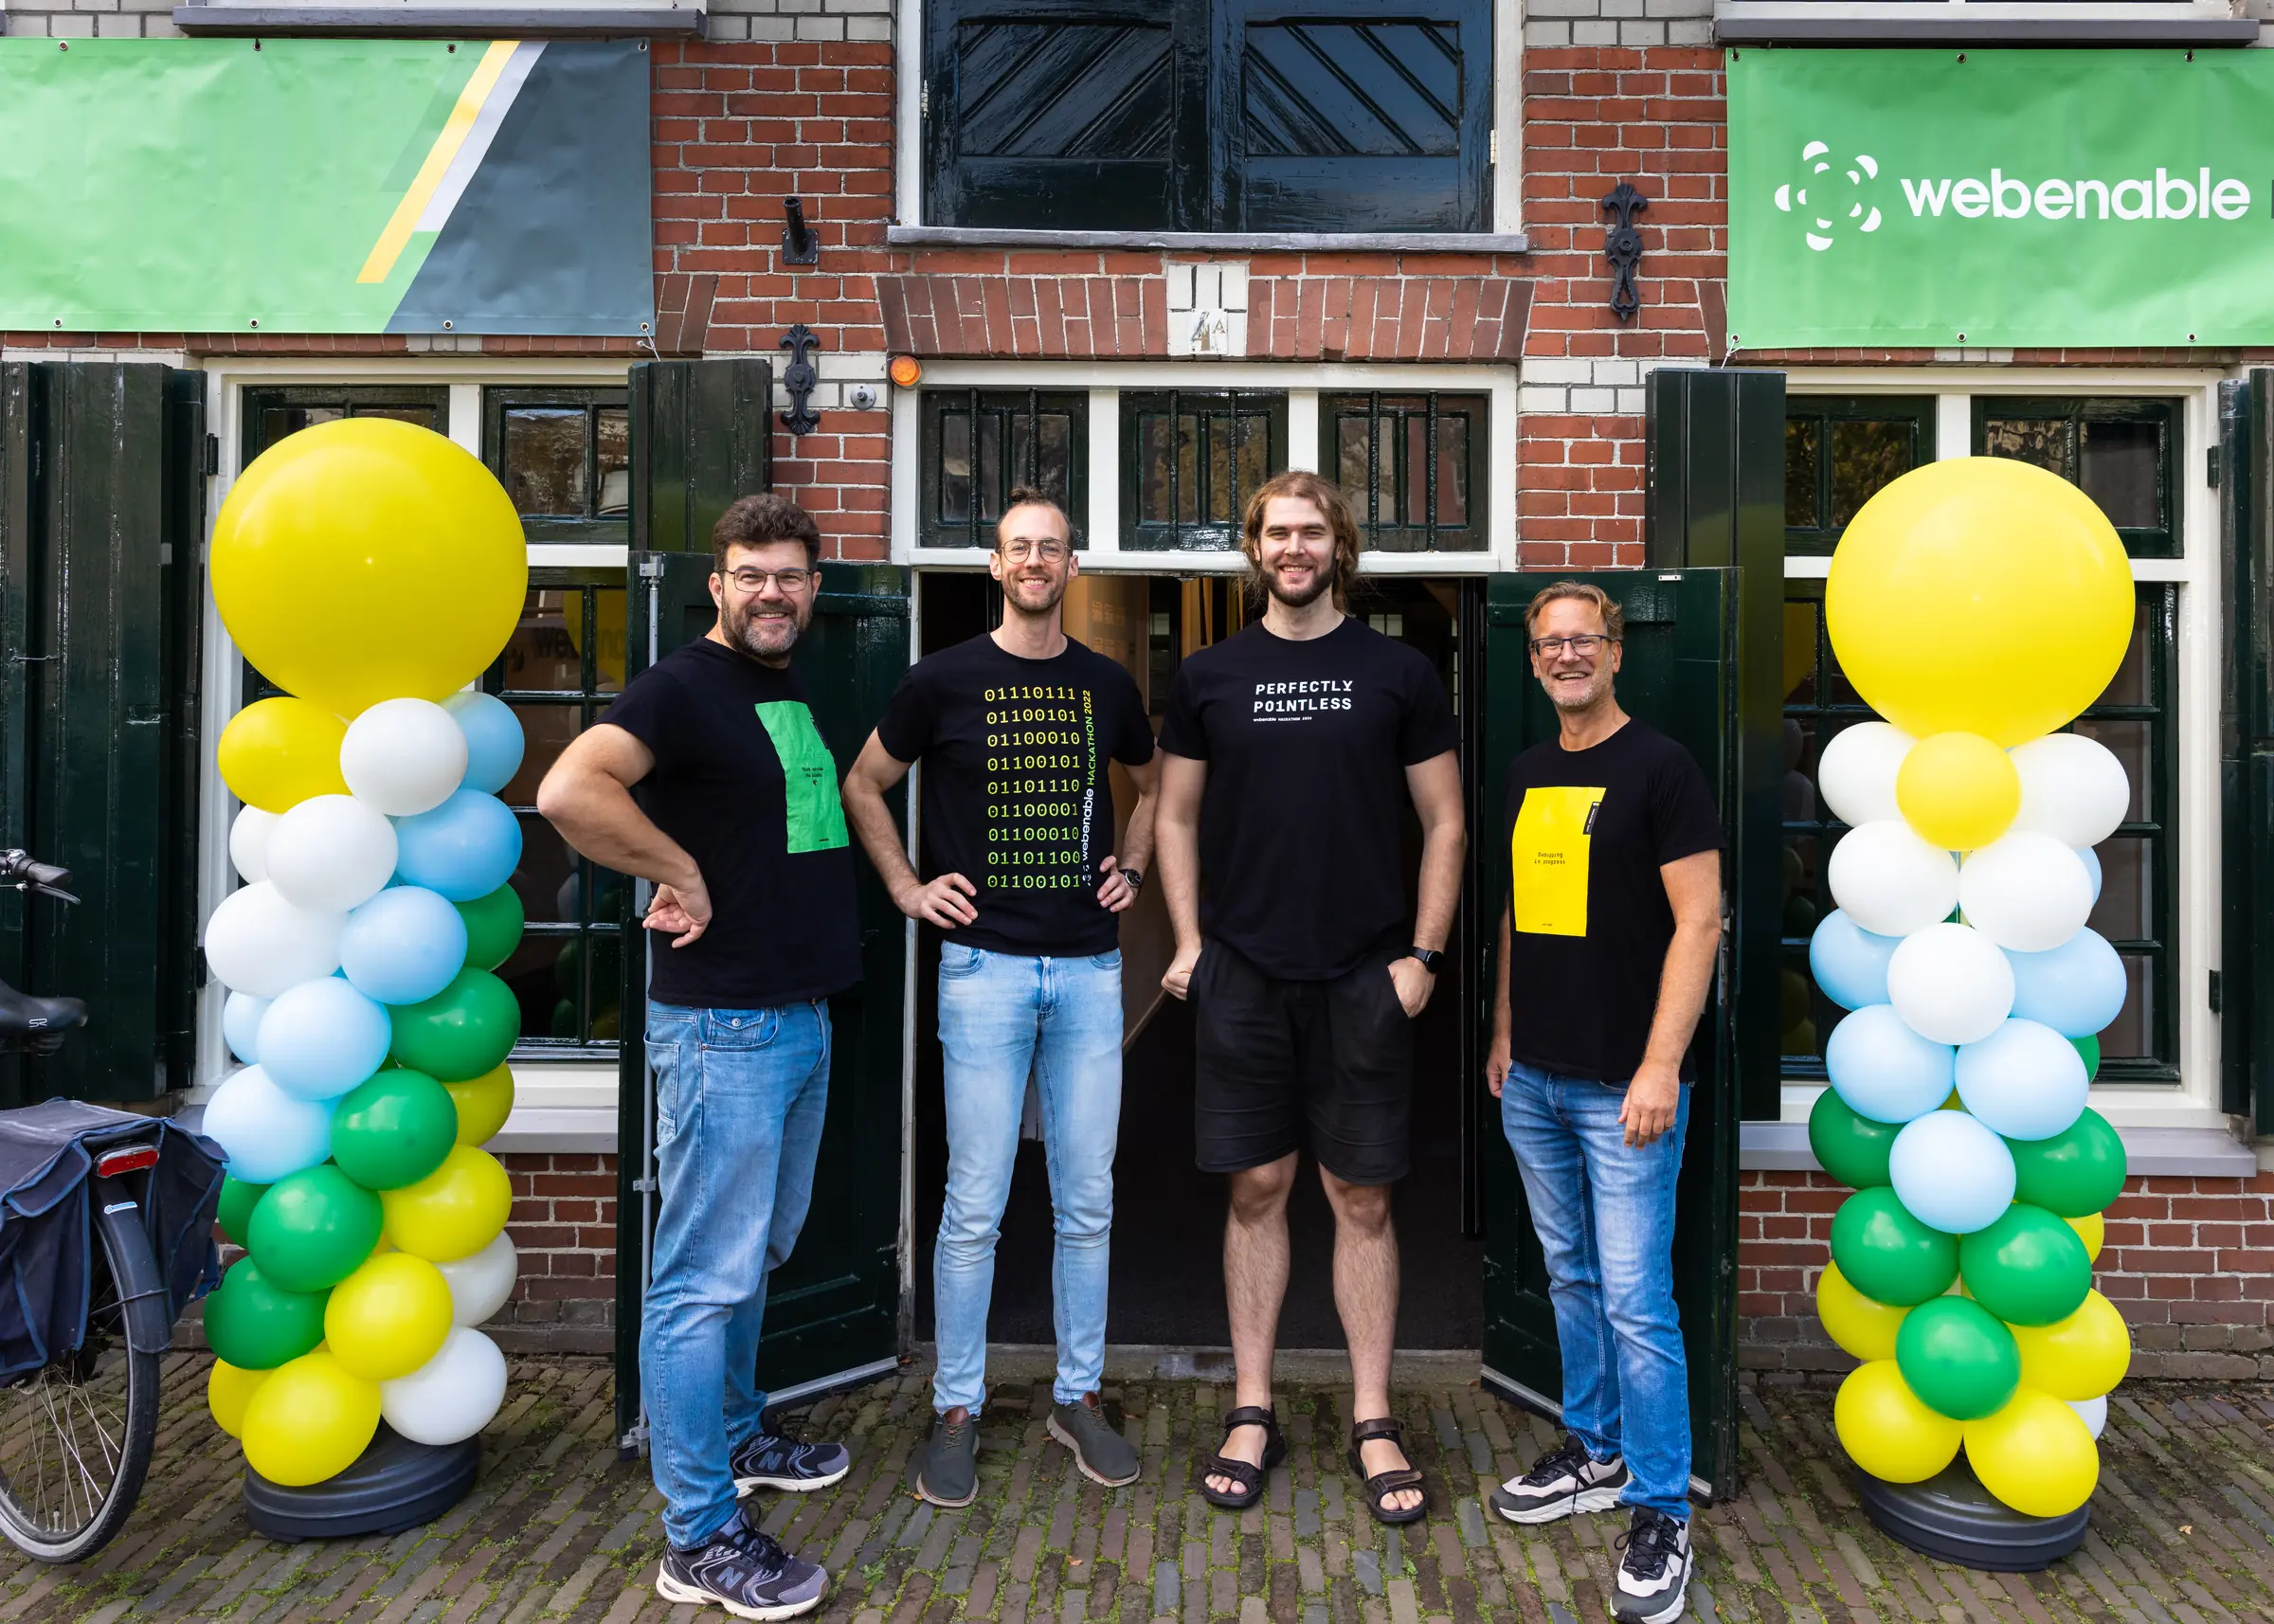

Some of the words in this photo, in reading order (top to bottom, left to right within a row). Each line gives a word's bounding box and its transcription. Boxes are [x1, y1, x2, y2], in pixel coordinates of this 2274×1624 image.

[1901, 167, 2251, 220] webenable
[984, 686, 1076, 702] 01110111
[1254, 679, 1354, 695] PERFECTLY
[1082, 690, 1092, 715] 2022
[986, 709, 1077, 725] 01100101
[987, 731, 1080, 748] 01100010
[1085, 716, 1096, 785] HACKATHON
[987, 755, 1080, 771] 01100101
[987, 779, 1080, 795] 01101110
[987, 803, 1078, 819] 01100001
[1081, 788, 1094, 861] webenable
[988, 826, 1079, 842] 01100010
[988, 850, 1080, 865] 01101100
[987, 874, 1080, 889] 01100101
[716, 1566, 745, 1591] N
